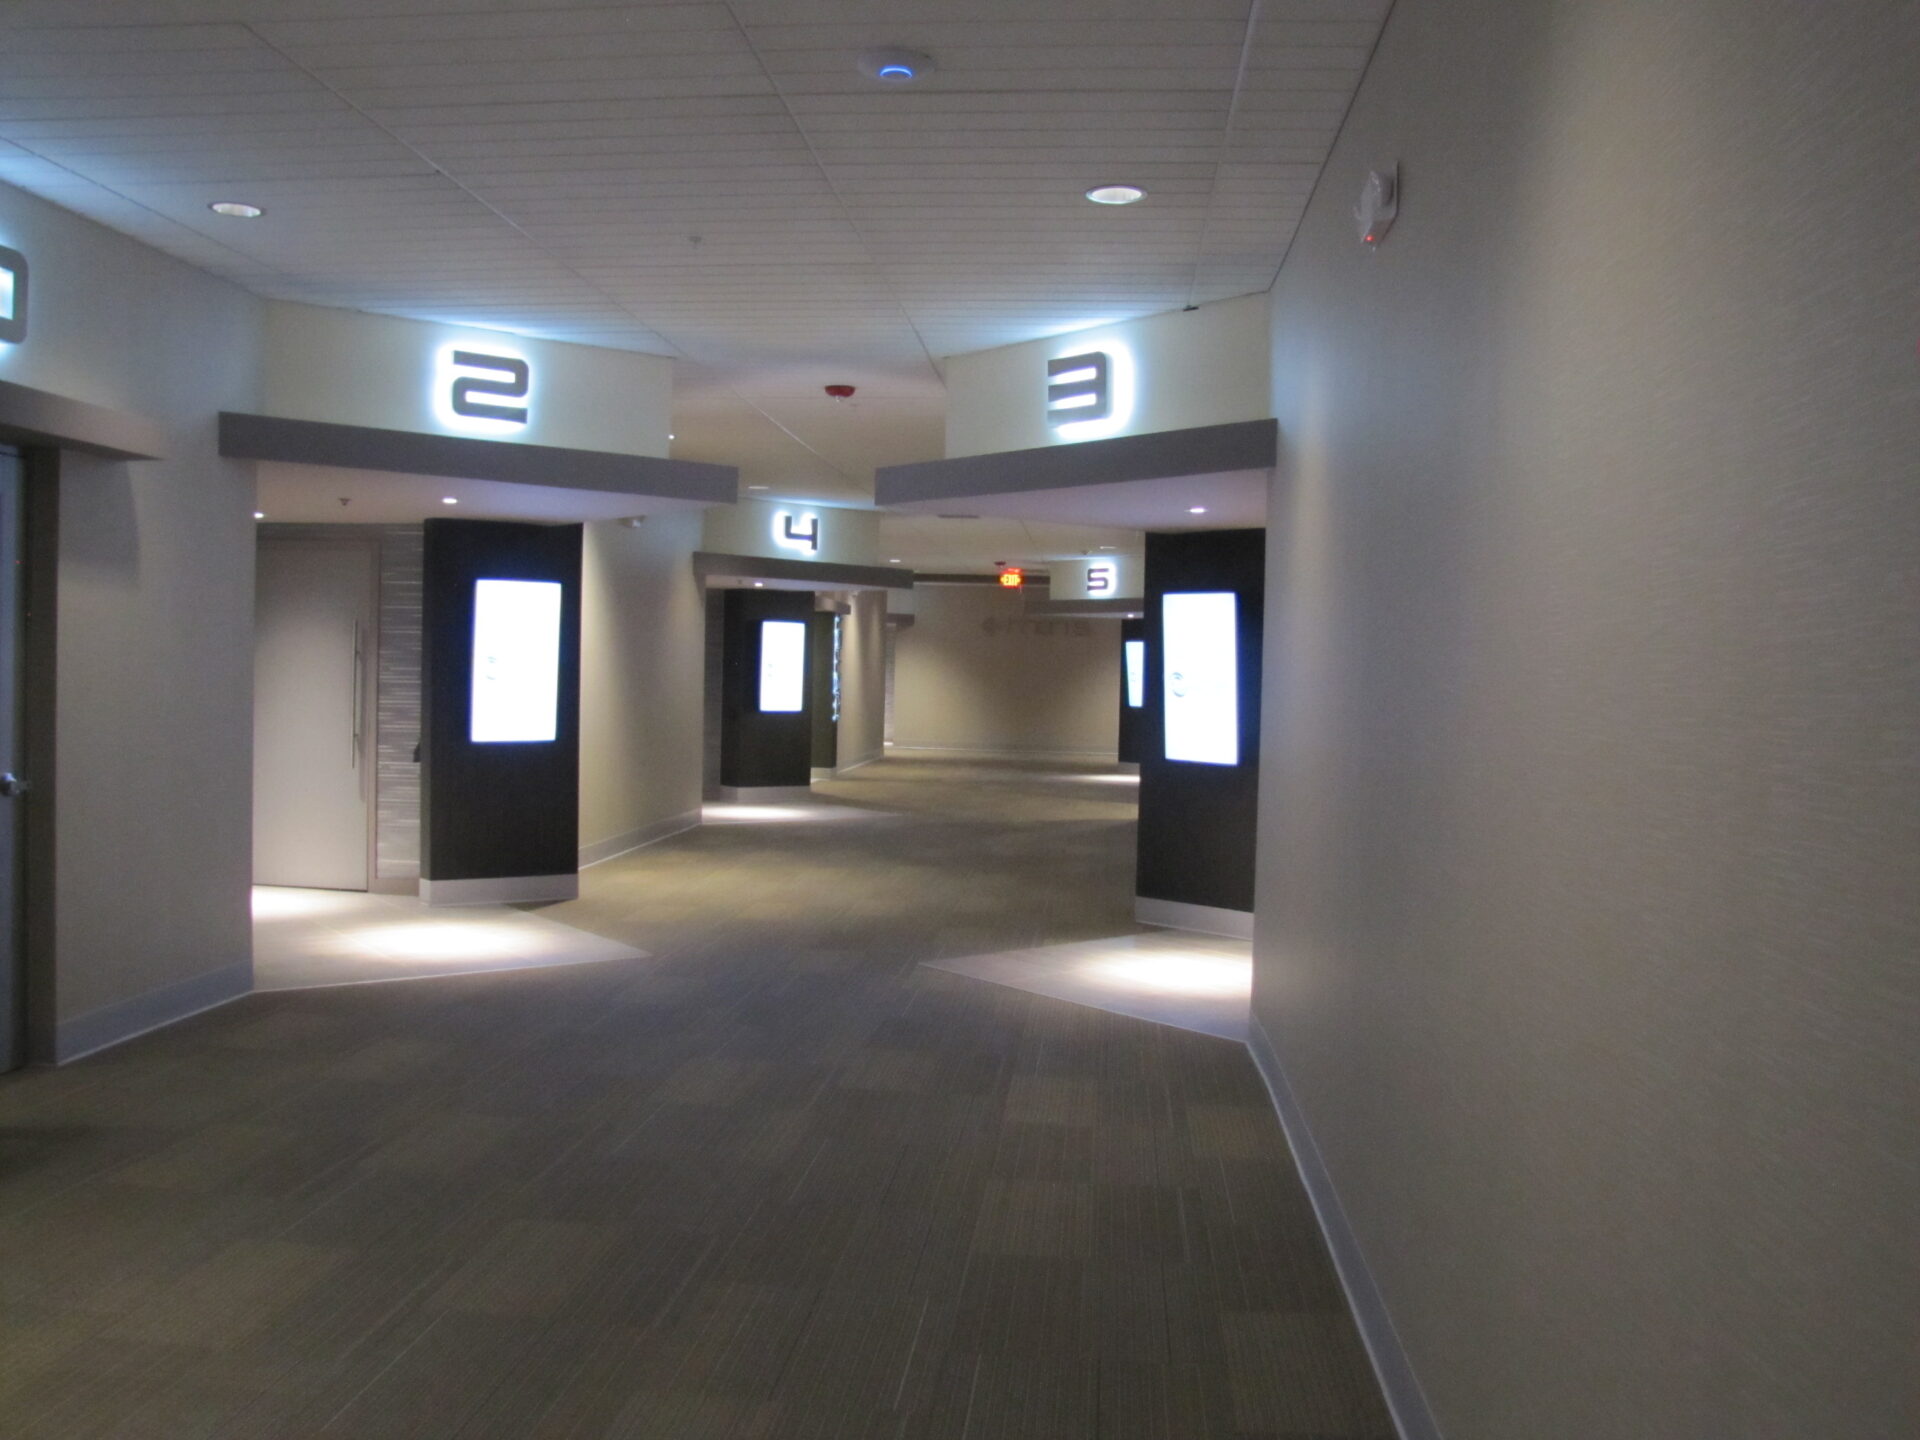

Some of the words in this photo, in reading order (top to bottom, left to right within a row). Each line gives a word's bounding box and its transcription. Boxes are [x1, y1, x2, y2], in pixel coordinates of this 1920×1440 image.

[452, 350, 529, 424] 2
[1047, 351, 1107, 428] 3
[784, 515, 819, 551] 4
[1087, 568, 1109, 591] 5
